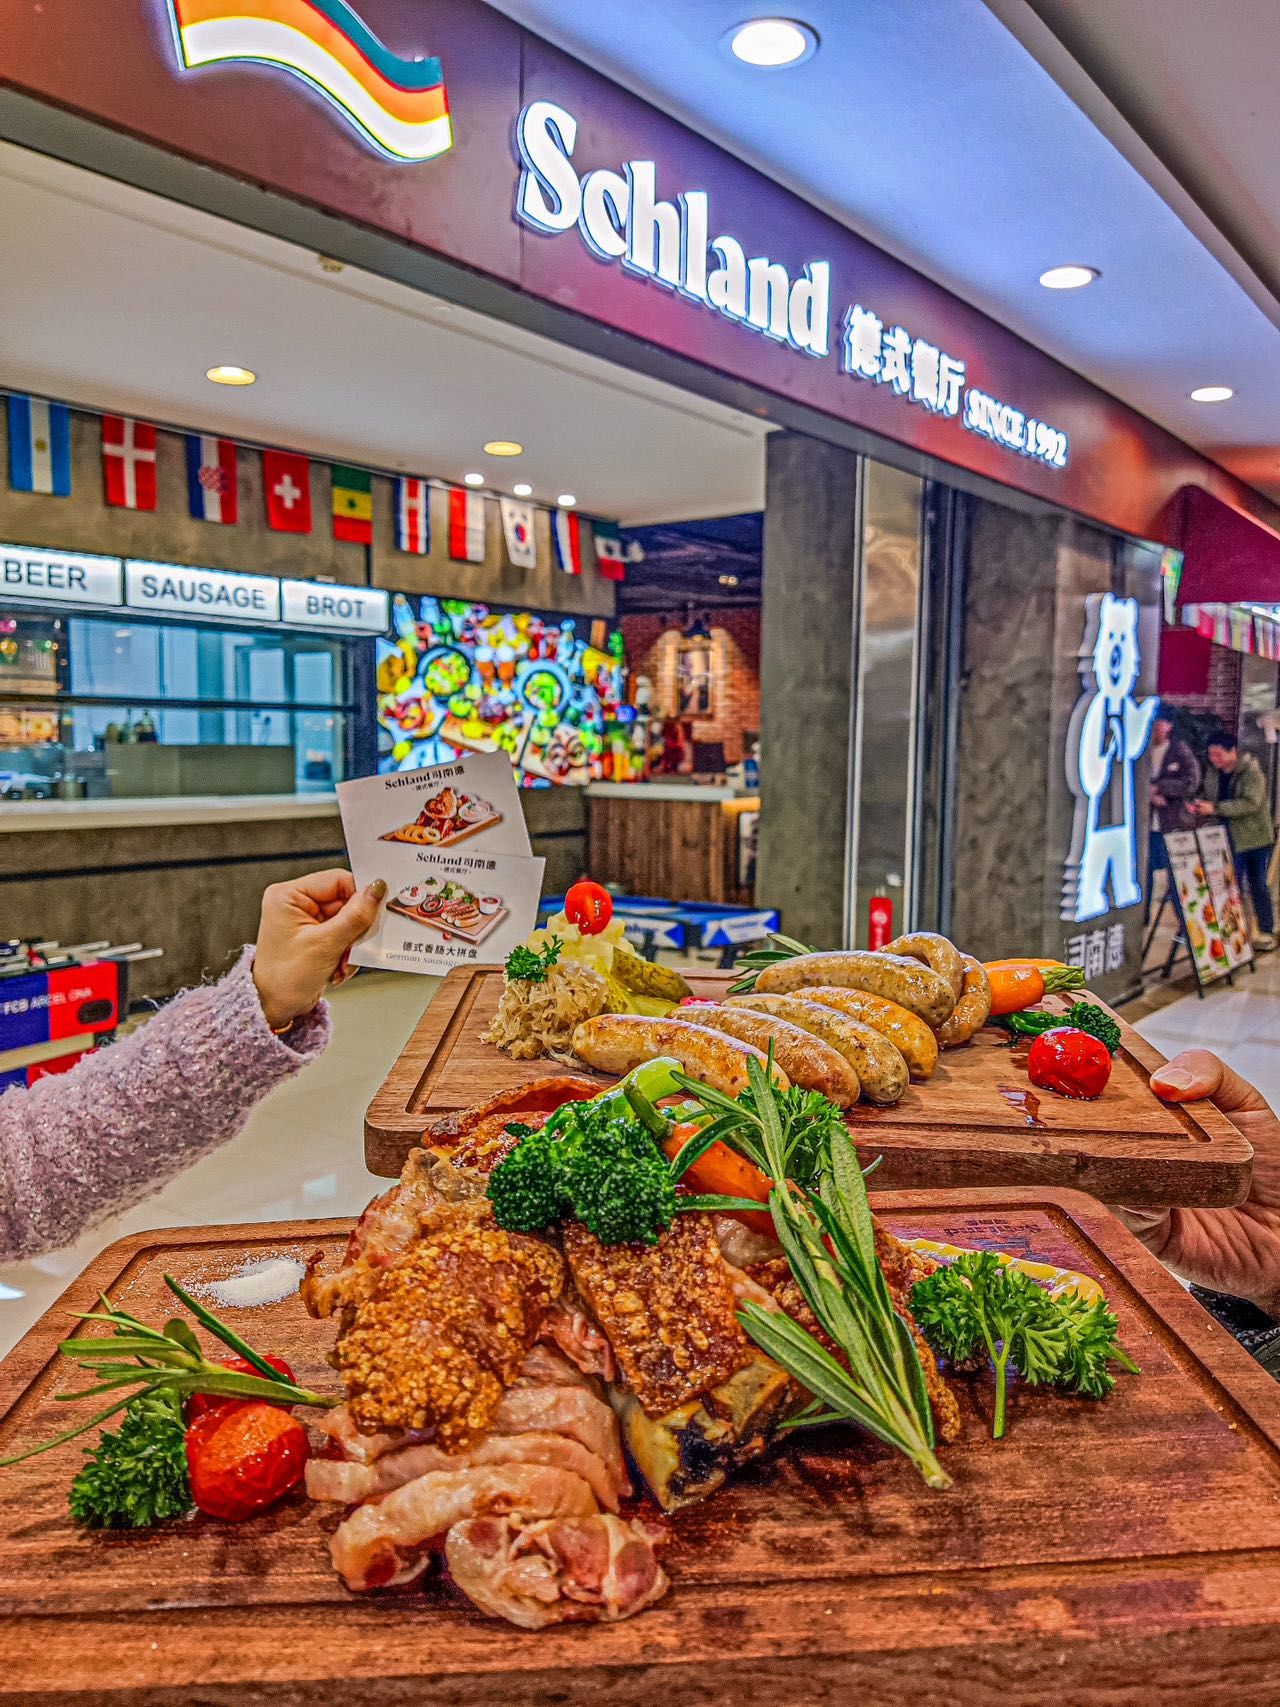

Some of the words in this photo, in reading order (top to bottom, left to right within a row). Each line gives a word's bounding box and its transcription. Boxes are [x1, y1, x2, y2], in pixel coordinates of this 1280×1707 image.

[517, 101, 830, 357] Schland
[845, 304, 965, 415] 德式餐厅
[965, 388, 1026, 448] SINCE
[1026, 419, 1068, 467] 1992
[5, 559, 88, 592] BEER
[141, 575, 265, 610] SAUSAGE
[306, 595, 365, 619] BROT
[385, 772, 430, 790] Schland
[416, 852, 462, 866] Schland
[386, 952, 420, 963] German
[403, 941, 477, 959] 德式香肠大拼盘
